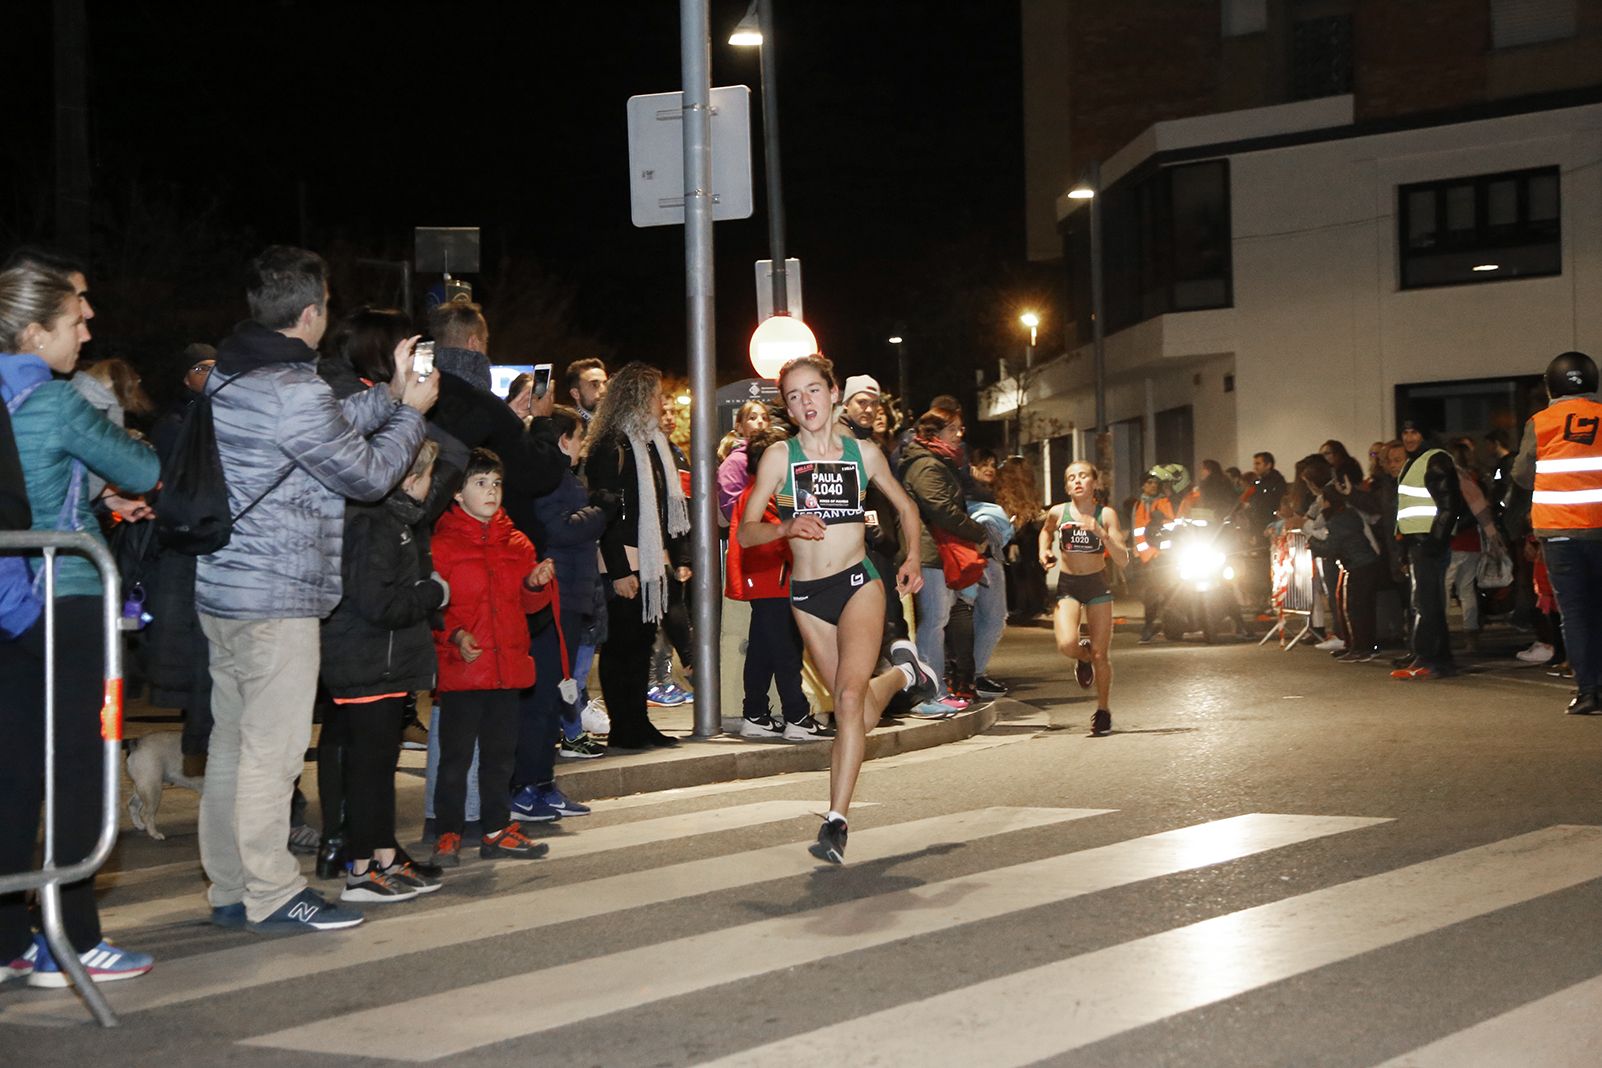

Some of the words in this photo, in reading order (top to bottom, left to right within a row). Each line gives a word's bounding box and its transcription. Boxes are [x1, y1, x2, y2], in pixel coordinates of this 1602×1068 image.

[812, 473, 843, 483] PAULA
[814, 483, 843, 495] 1040
[1073, 529, 1087, 537] LAIA
[1070, 536, 1090, 545] 1020
